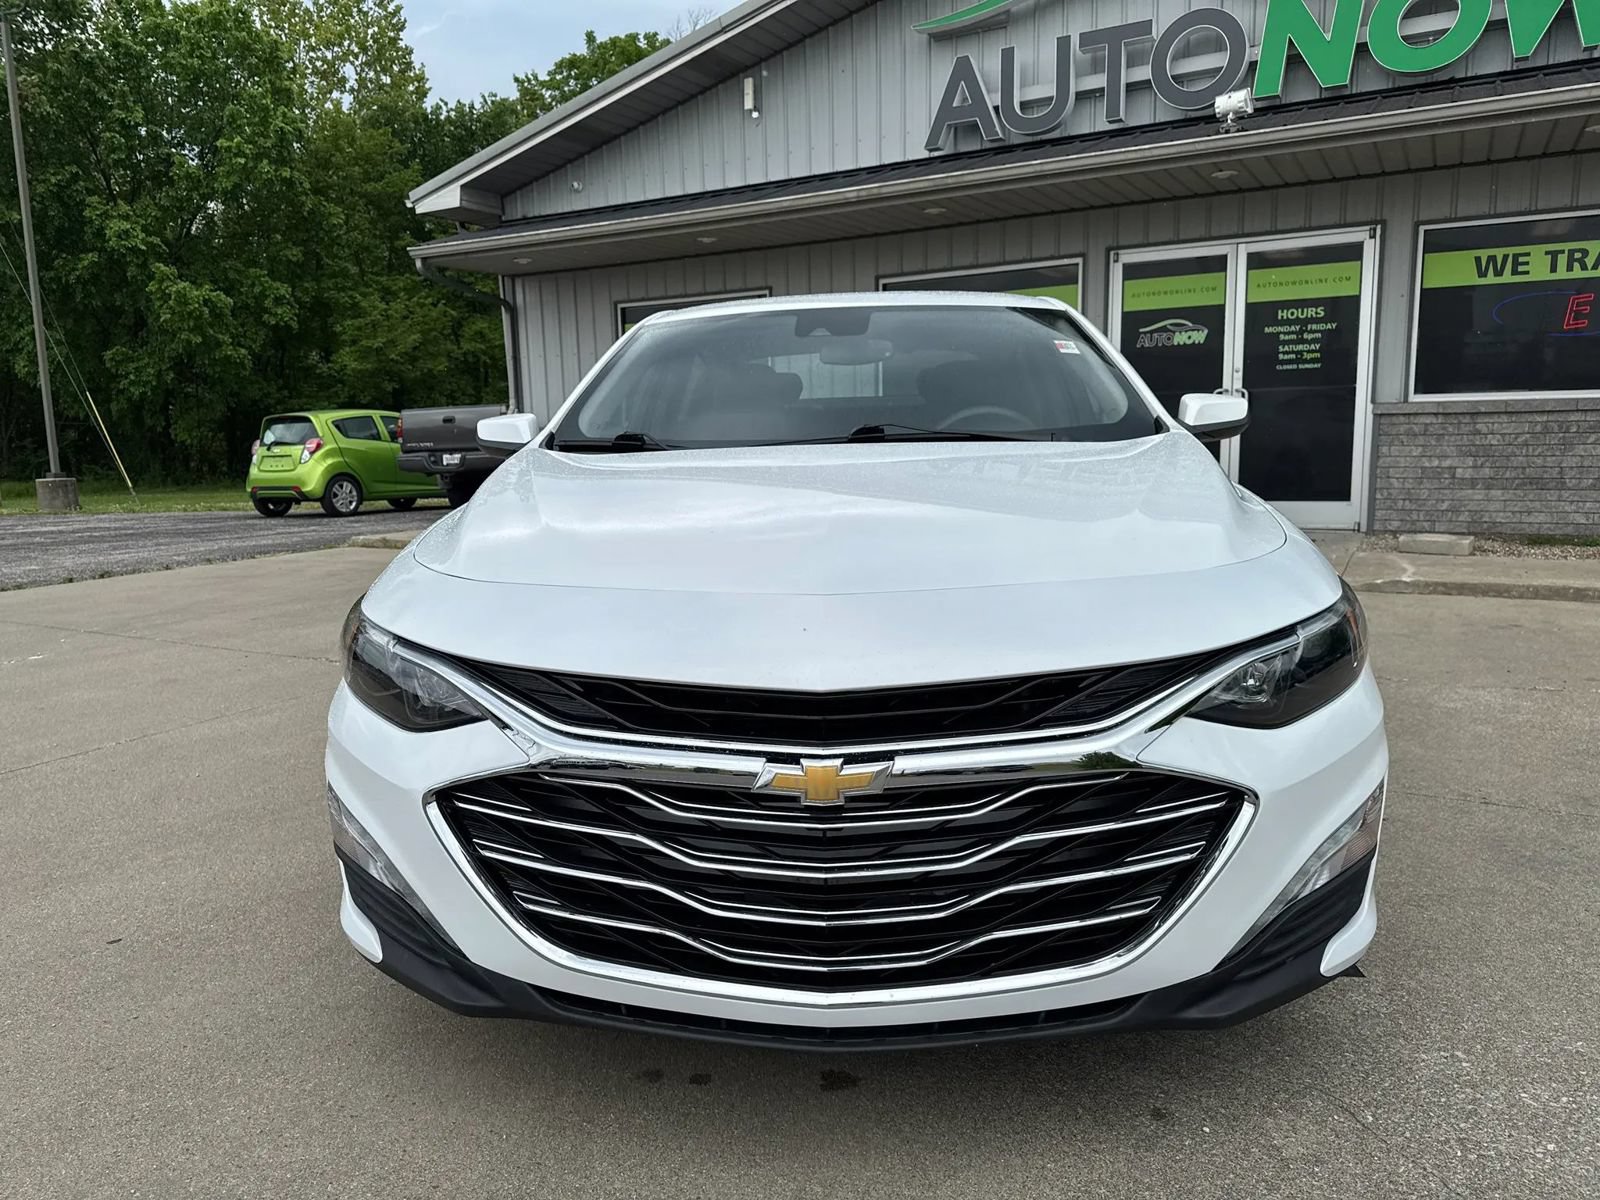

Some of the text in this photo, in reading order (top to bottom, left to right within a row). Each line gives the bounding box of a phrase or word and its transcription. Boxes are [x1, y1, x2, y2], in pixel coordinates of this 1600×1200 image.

[1474, 252, 1531, 279] WE
[1277, 306, 1325, 320] HOURS
[1563, 293, 1595, 330] E
[1264, 324, 1301, 334] MONDAY
[1307, 322, 1337, 331] FRIDAY
[1136, 330, 1207, 348] AUTONOW
[1303, 332, 1321, 340] 6pm
[1278, 343, 1321, 352] SATURDAY
[1302, 352, 1320, 360] 3pm
